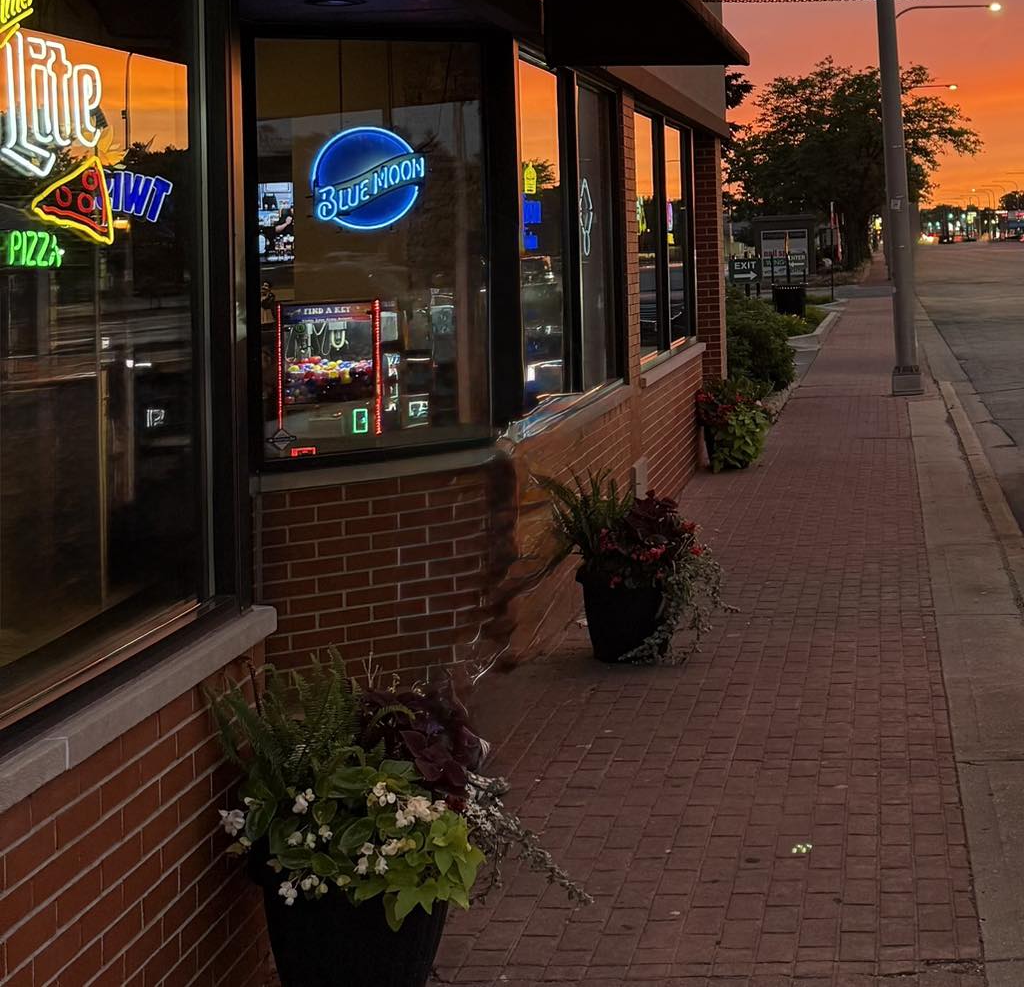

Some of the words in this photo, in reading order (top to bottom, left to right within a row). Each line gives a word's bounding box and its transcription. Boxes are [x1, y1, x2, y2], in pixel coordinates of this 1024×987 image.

[0, 30, 103, 178] Lite
[317, 178, 370, 221] BLUE
[371, 156, 425, 195] MOON
[9, 229, 64, 267] PIZZA
[734, 260, 757, 270] EXIT
